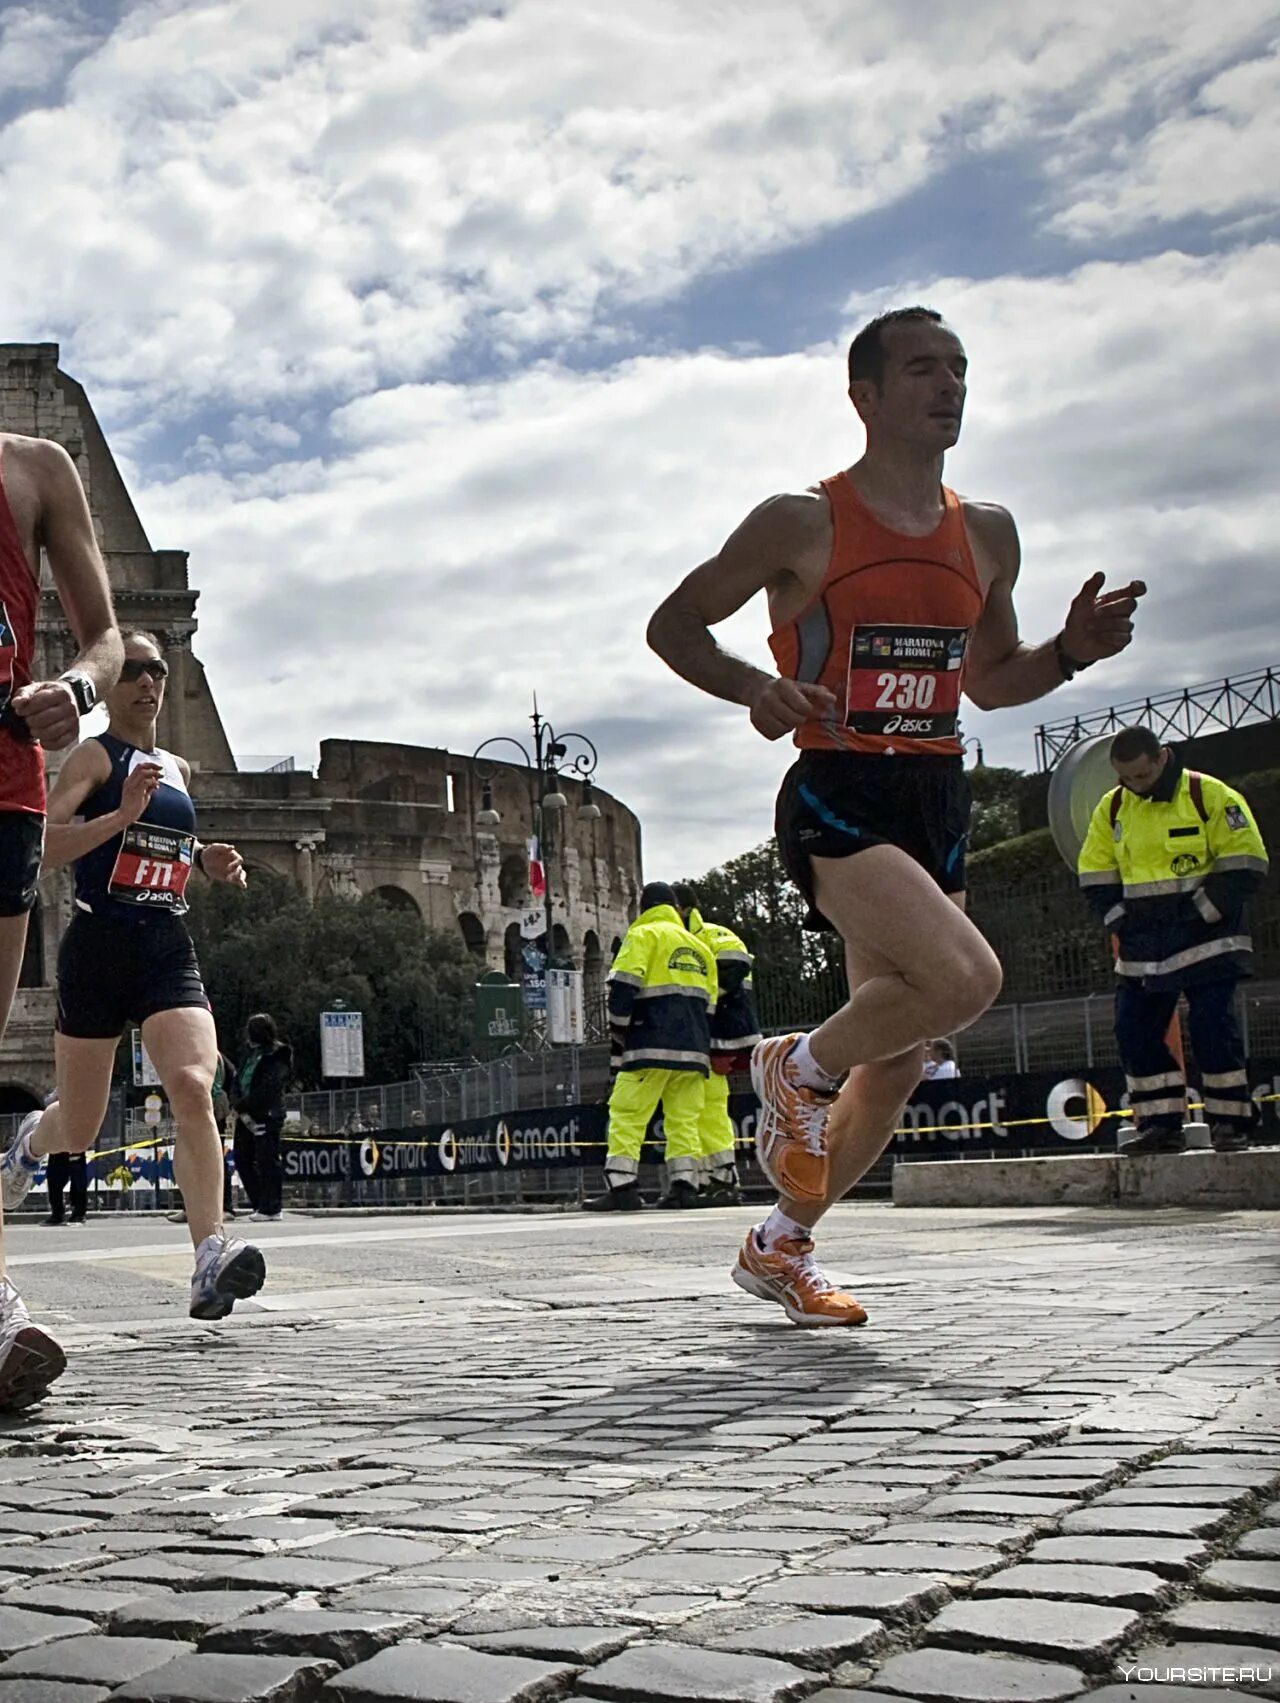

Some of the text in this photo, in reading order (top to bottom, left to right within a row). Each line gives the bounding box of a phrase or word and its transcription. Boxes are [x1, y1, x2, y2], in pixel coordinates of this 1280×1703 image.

[893, 638, 944, 649] MARATONA
[905, 648, 931, 657] ROMA
[875, 672, 937, 709] 230
[900, 719, 933, 732] asics
[896, 1090, 1011, 1142] mart
[285, 1143, 350, 1175] smart
[511, 1117, 580, 1160] smart
